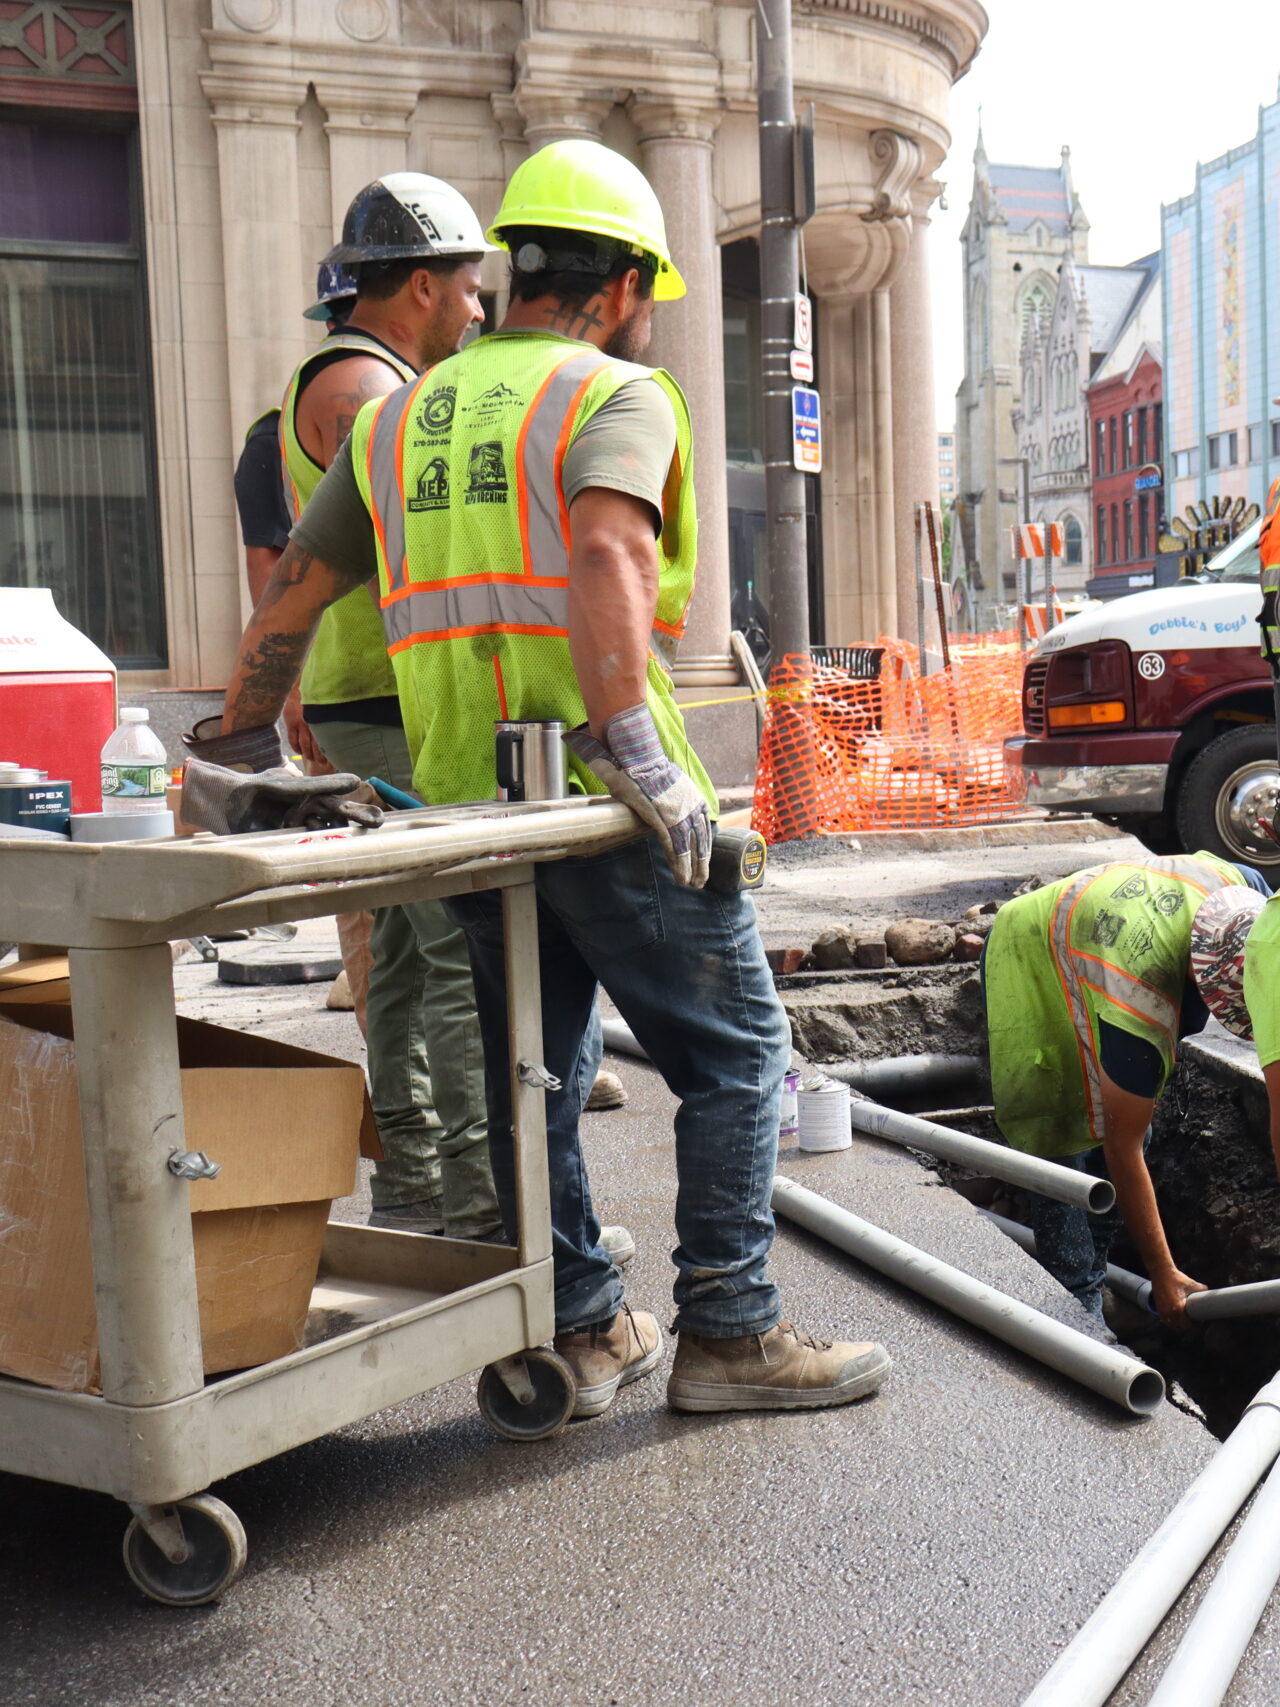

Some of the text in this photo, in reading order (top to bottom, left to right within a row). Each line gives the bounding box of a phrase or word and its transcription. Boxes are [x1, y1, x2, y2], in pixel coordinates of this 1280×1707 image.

[1149, 615, 1247, 636] Debbie's Boys
[1141, 658, 1161, 675] 63
[29, 791, 64, 800] IPEX
